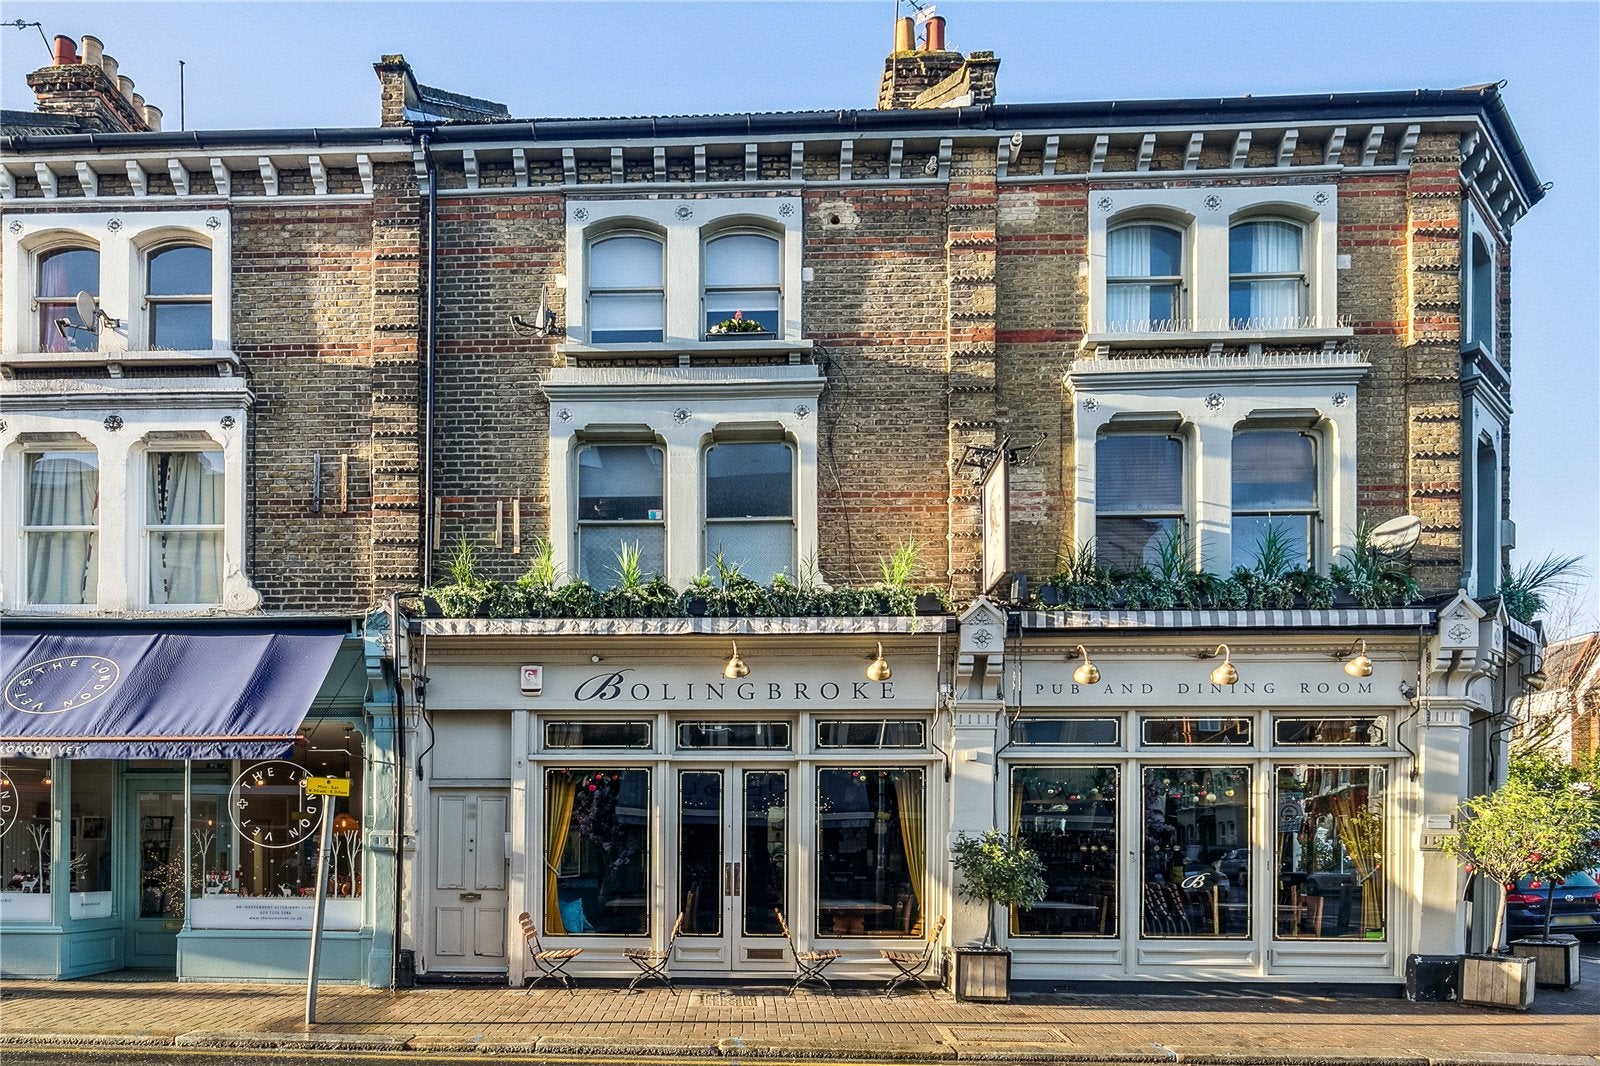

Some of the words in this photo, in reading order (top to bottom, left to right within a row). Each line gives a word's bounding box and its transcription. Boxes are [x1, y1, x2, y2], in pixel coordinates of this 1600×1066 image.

[35, 660, 79, 674] THE
[63, 662, 112, 708] LONDON
[574, 669, 895, 701] BOLINGBROKE
[1035, 683, 1080, 694] PUB
[1104, 683, 1153, 694] AND
[1177, 683, 1275, 694] DINING
[1300, 683, 1372, 694] ROOM
[14, 692, 43, 709] VET
[58, 746, 81, 754] VET
[241, 767, 275, 789] THE
[241, 819, 273, 841] VET
[1181, 872, 1211, 889] B
